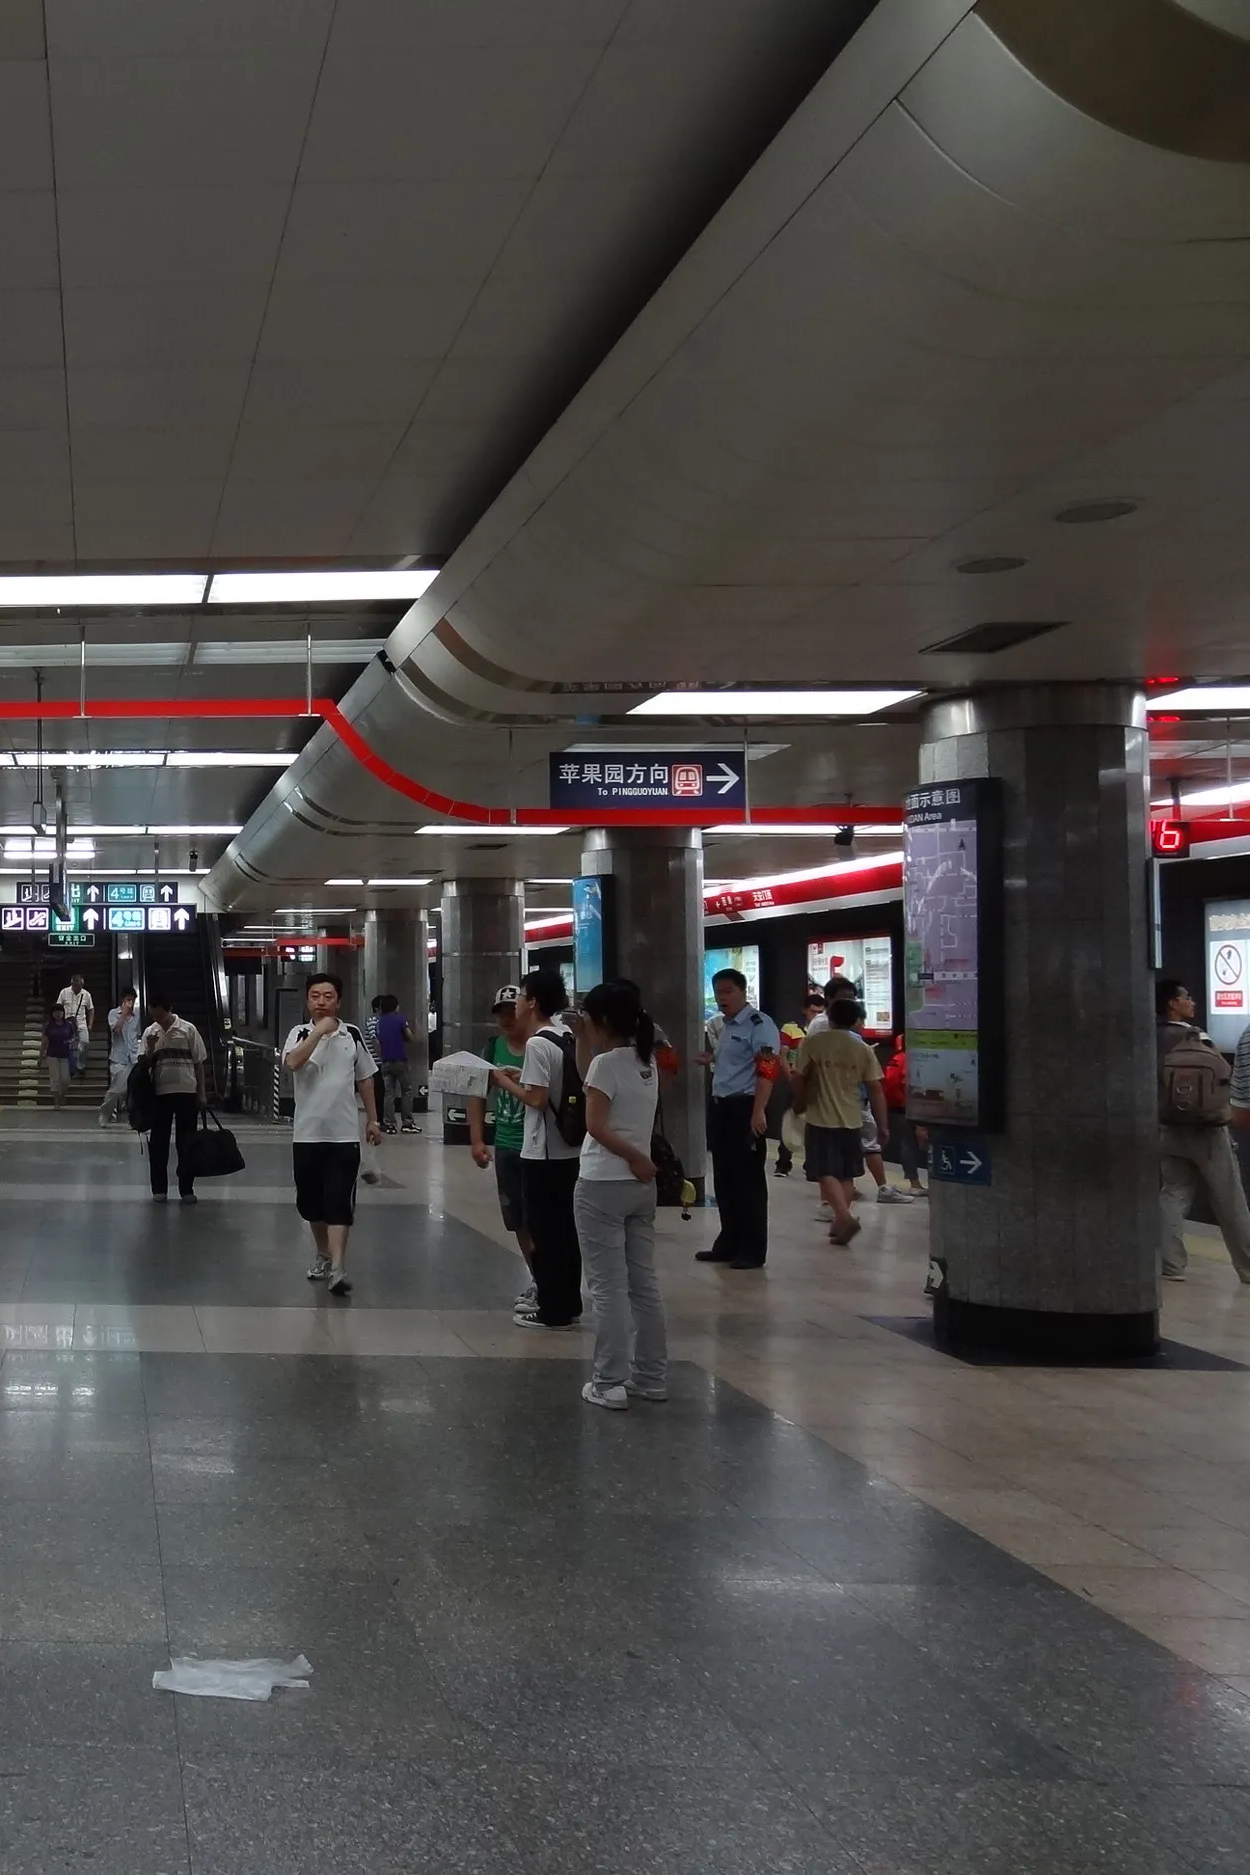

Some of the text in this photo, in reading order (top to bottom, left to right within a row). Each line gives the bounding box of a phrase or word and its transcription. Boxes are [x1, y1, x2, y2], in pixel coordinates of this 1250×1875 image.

[559, 764, 669, 784] 苹果园方向
[598, 787, 668, 796] To PINGGUOYUAN
[924, 812, 942, 821] Area
